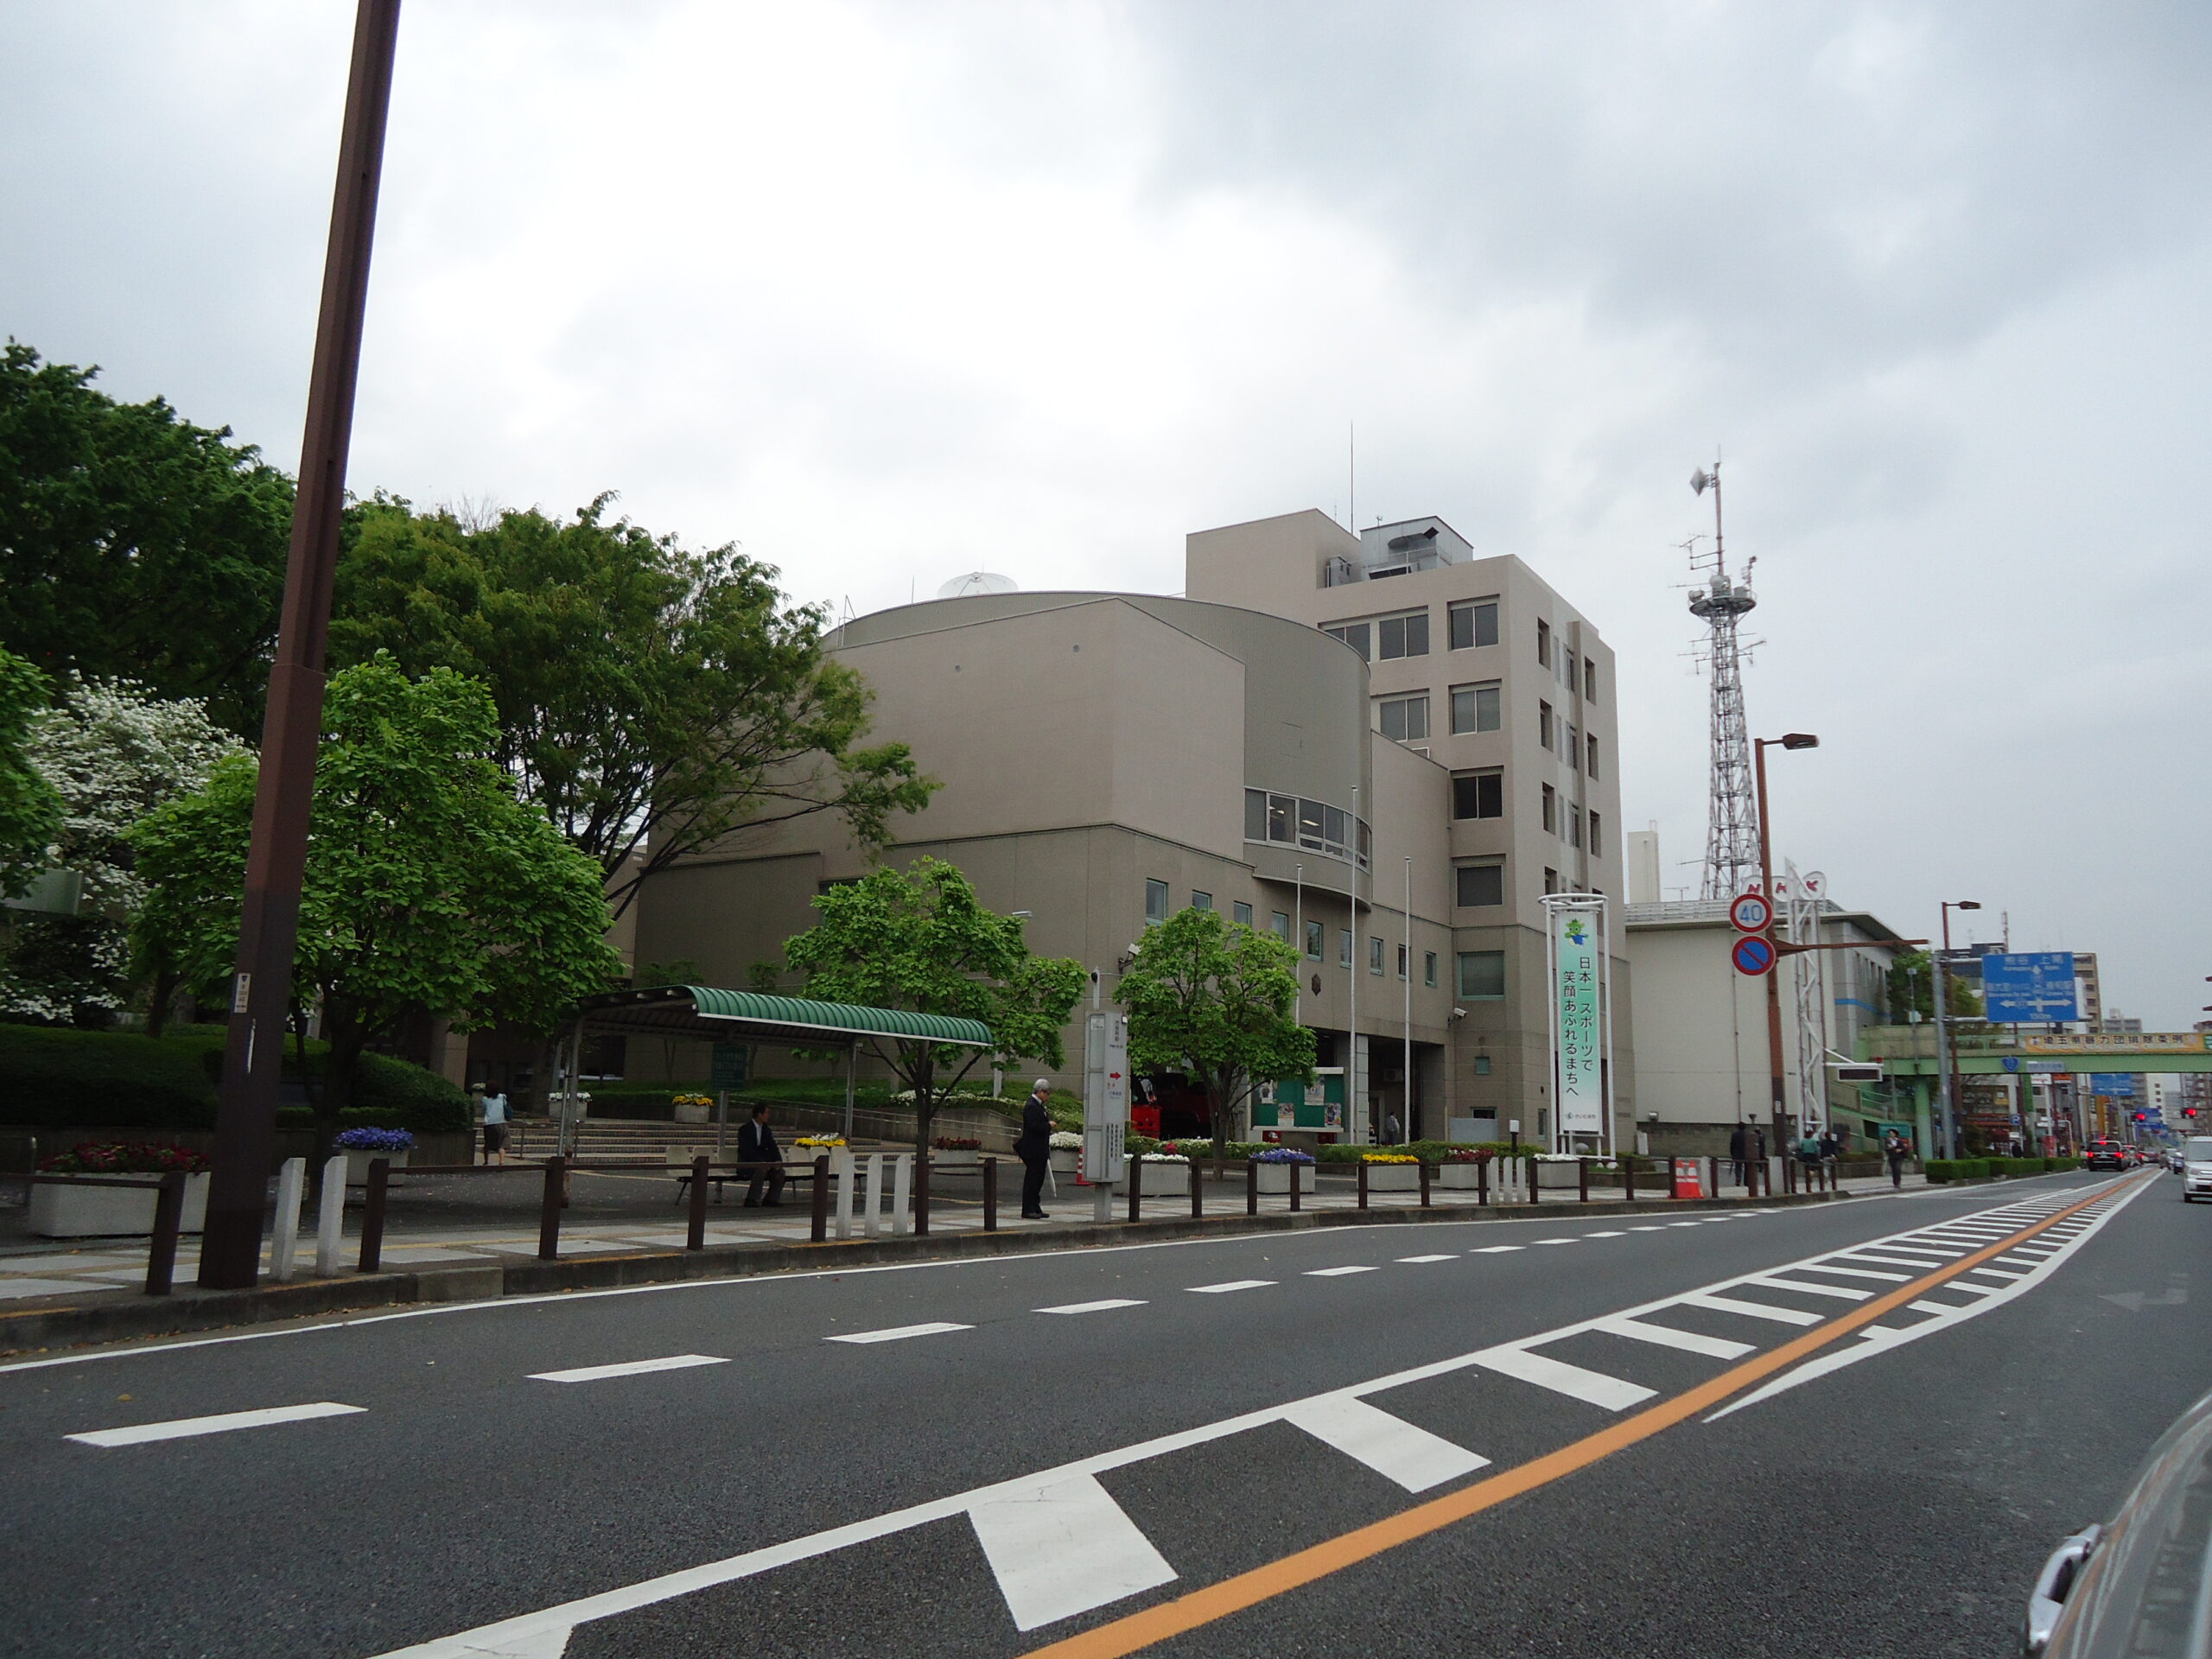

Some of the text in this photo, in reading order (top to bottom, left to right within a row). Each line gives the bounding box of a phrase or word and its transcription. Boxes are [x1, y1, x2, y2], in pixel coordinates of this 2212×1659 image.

[1740, 905, 1763, 922] 40
[1563, 970, 1580, 1096] 笑顔あふれるまちへ
[1580, 1003, 1593, 1071] スポーツで
